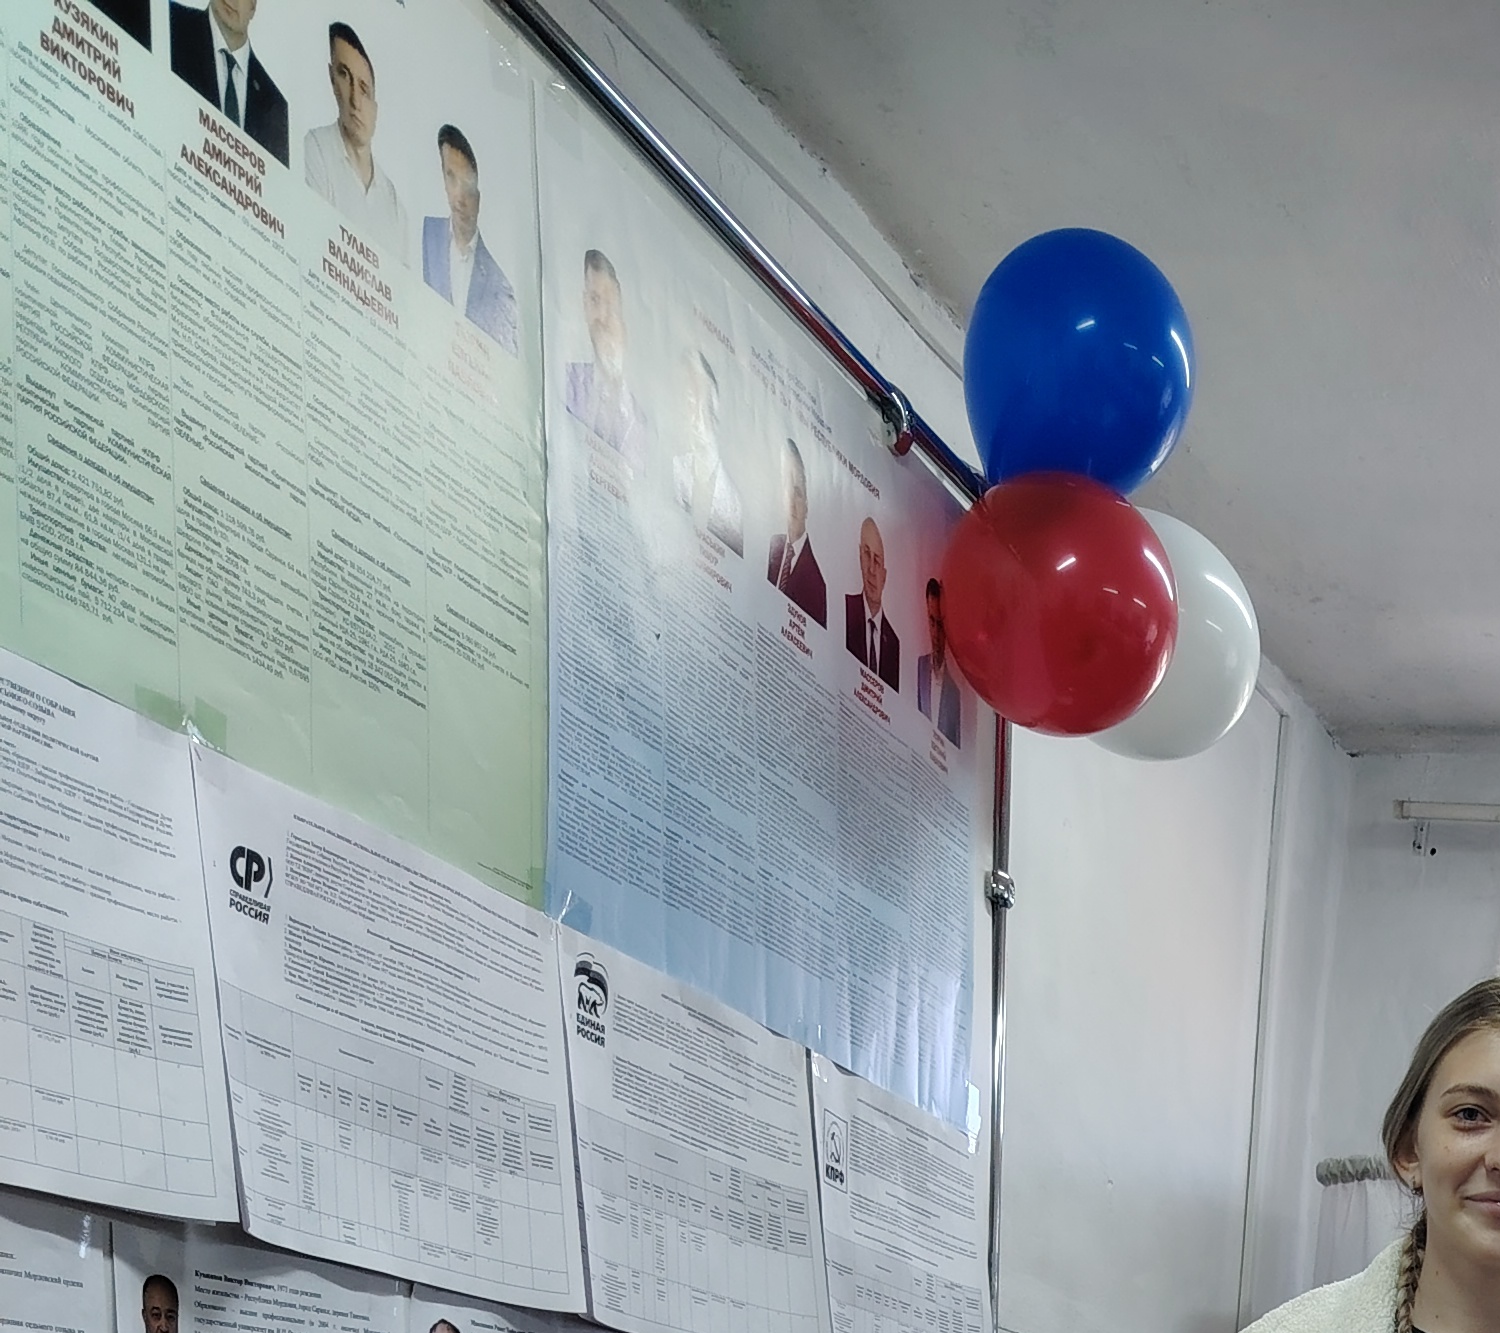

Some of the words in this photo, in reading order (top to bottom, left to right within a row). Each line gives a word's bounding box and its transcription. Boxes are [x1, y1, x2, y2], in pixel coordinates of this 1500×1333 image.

[40, 29, 135, 119] ВИКТОРОВИЧ
[52, 15, 122, 83] ДМИТРИЙ
[199, 107, 266, 176] МАССЕРОВ
[203, 137, 262, 197] ДМИТРИЙ
[180, 144, 285, 239] АЛЕКСАНДРОВИЧ
[328, 238, 392, 302] ВЛАДИСЛАВ
[339, 224, 380, 269] ТУЛАЕВ
[322, 257, 399, 329] ГЕННАДЬЕВИЧ
[229, 888, 271, 913] СПРАВЕДЛИВАЯ
[229, 898, 269, 925] РОССИЯ
[576, 1013, 606, 1035] ЕДИНАЯ
[577, 1026, 606, 1048] РОССИЯ
[825, 1164, 845, 1187] КПРФ
